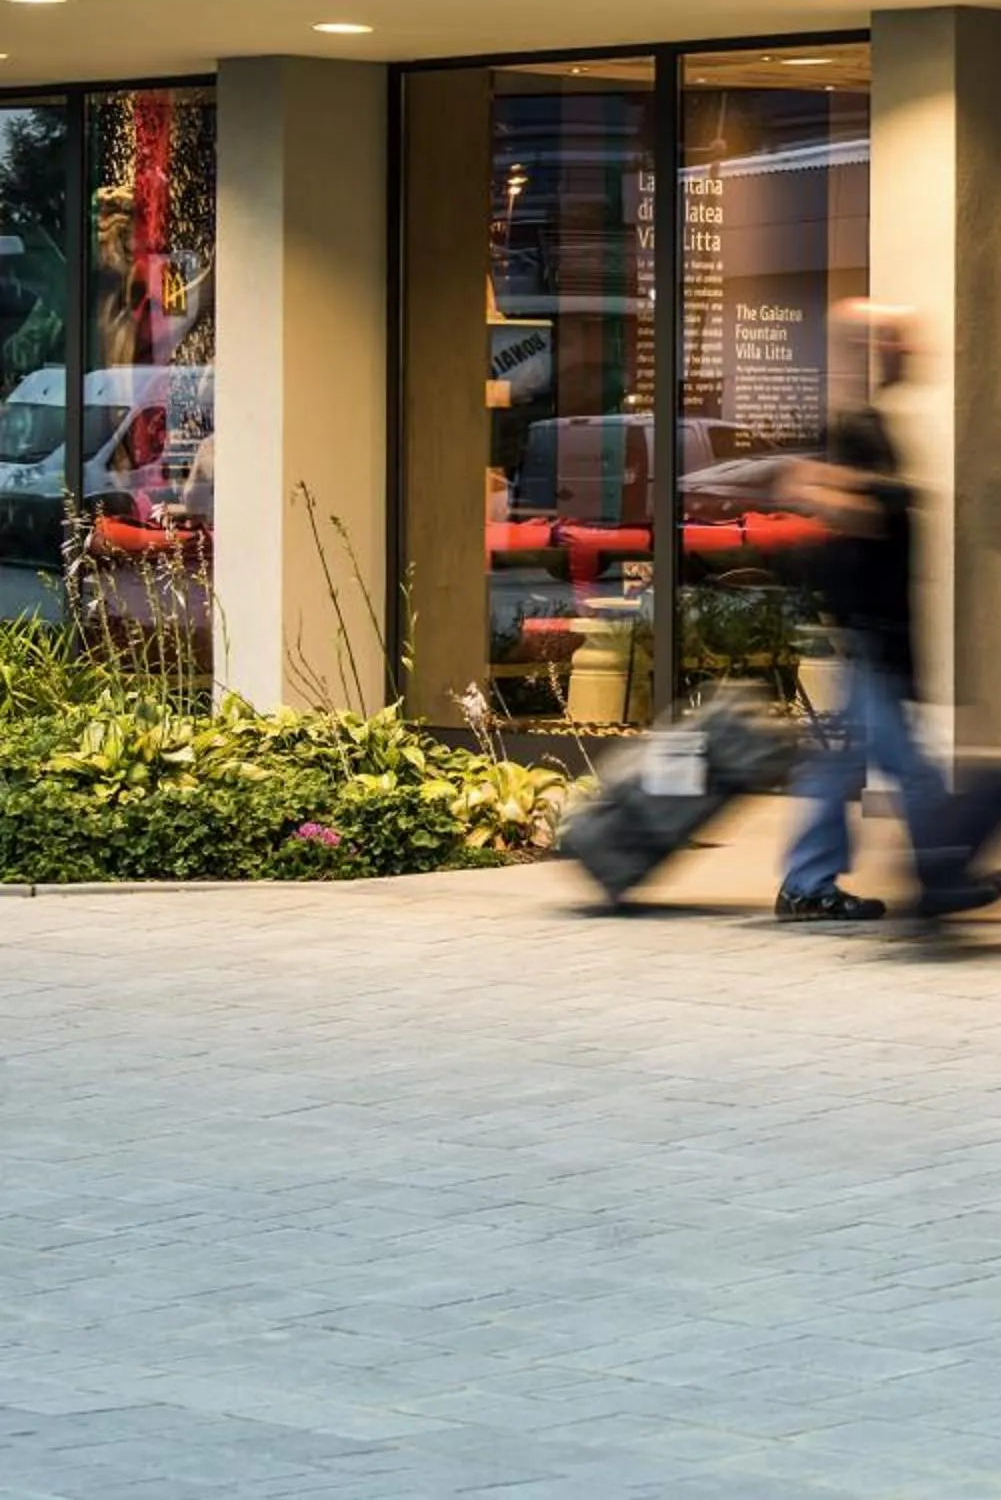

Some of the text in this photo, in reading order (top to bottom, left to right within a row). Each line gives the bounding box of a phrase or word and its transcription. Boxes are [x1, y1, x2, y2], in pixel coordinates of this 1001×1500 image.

[736, 304, 757, 321] The
[735, 324, 787, 341] Fountain
[736, 343, 793, 361] Villa Litta
